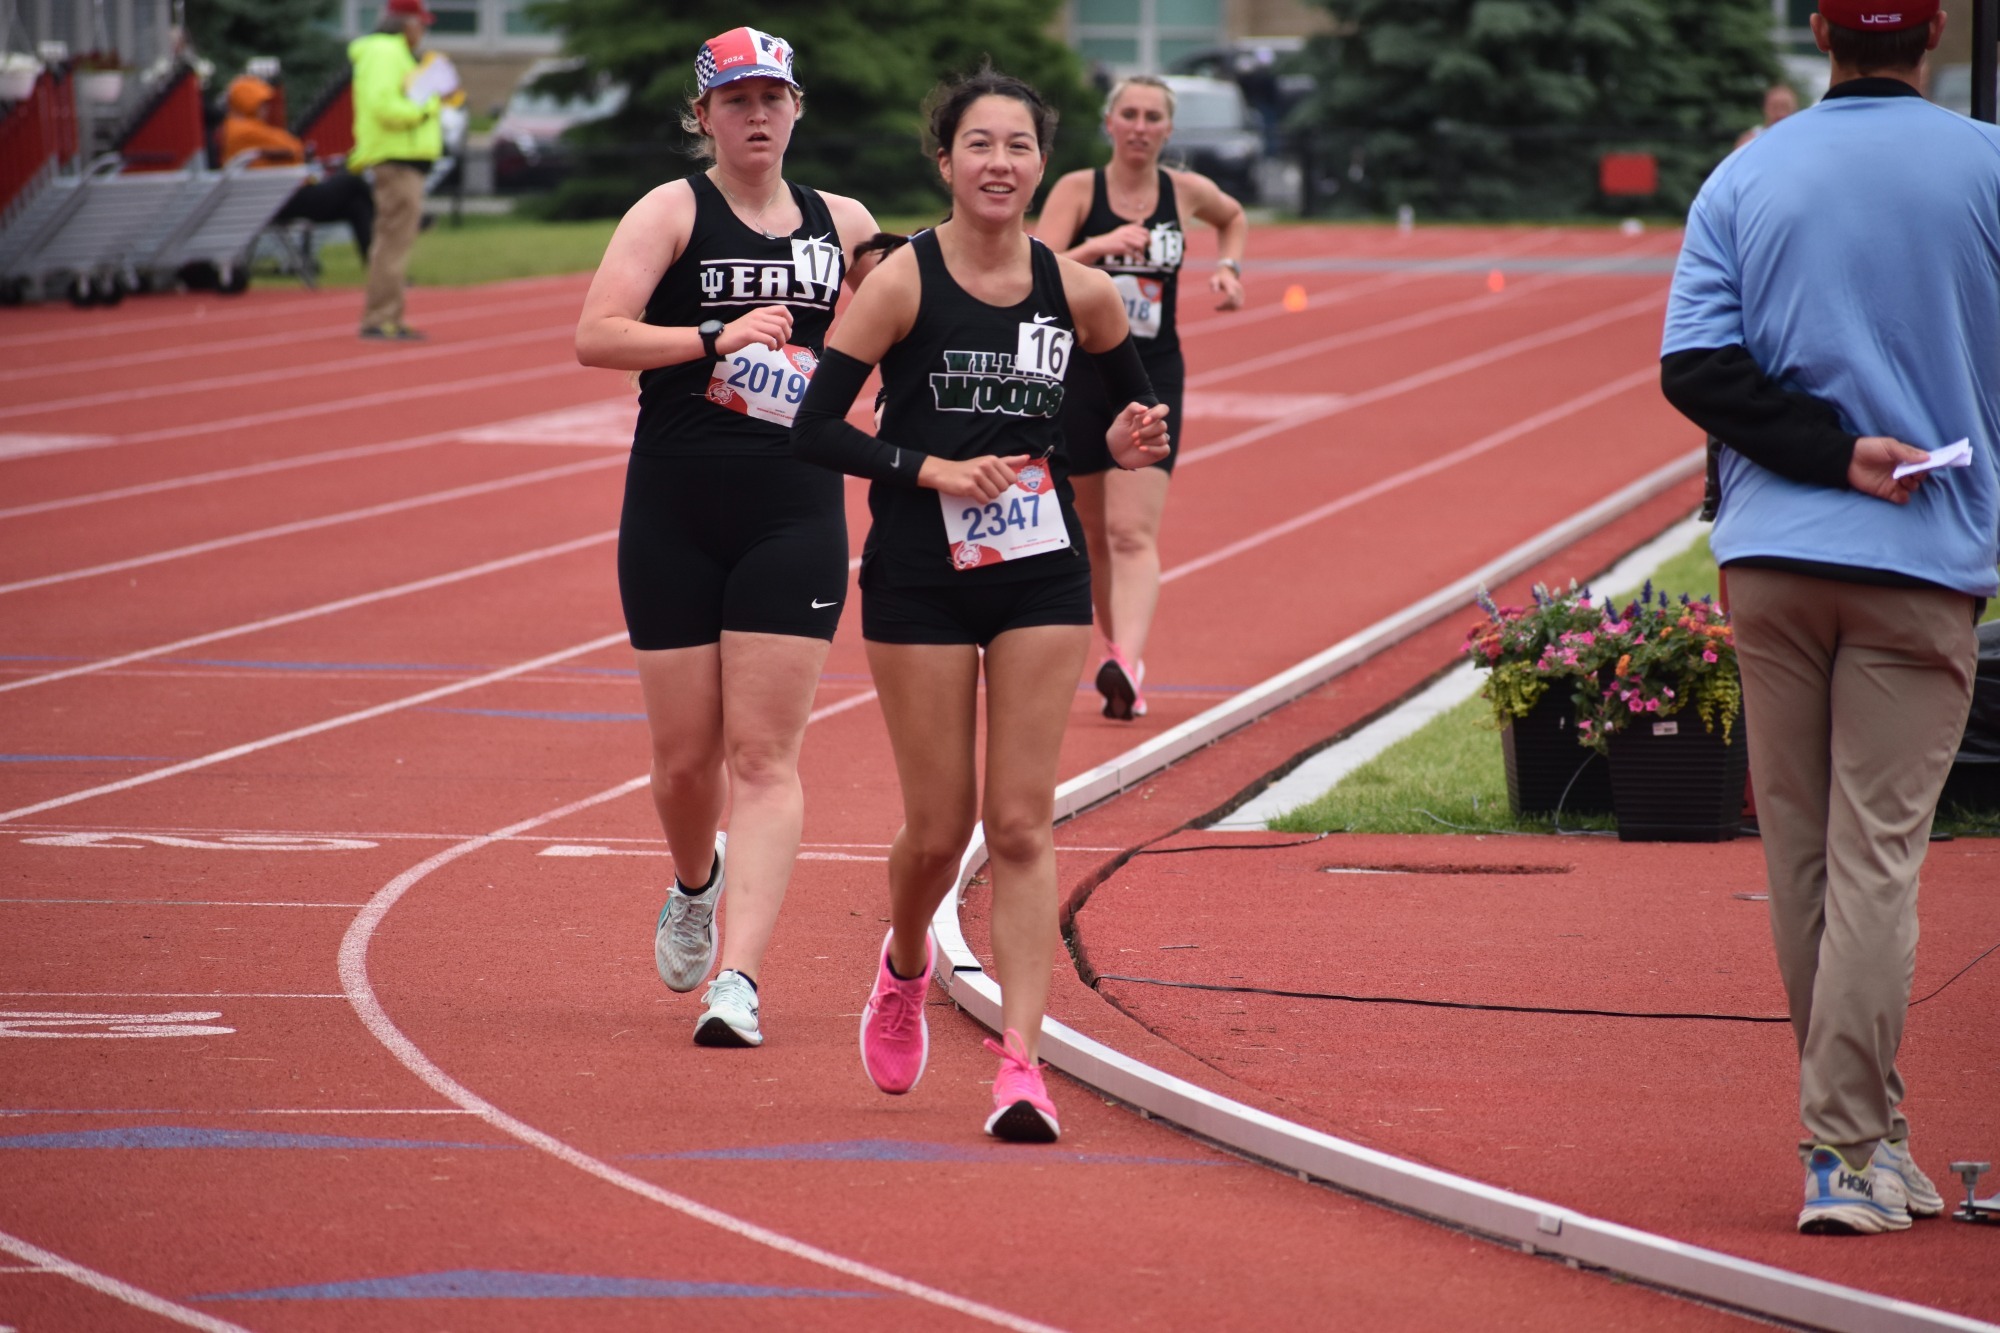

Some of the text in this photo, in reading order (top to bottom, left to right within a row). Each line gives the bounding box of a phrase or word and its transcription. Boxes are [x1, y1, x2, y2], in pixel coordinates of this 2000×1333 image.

[1861, 13, 1902, 23] UCS
[722, 54, 744, 66] 2024
[801, 243, 834, 284] 17
[943, 350, 1060, 381] WILL
[1030, 327, 1064, 375] 16
[727, 356, 806, 404] 2019
[929, 373, 1065, 418] WOODS
[962, 494, 1040, 541] 2347
[1838, 1171, 1873, 1200] HOKA
